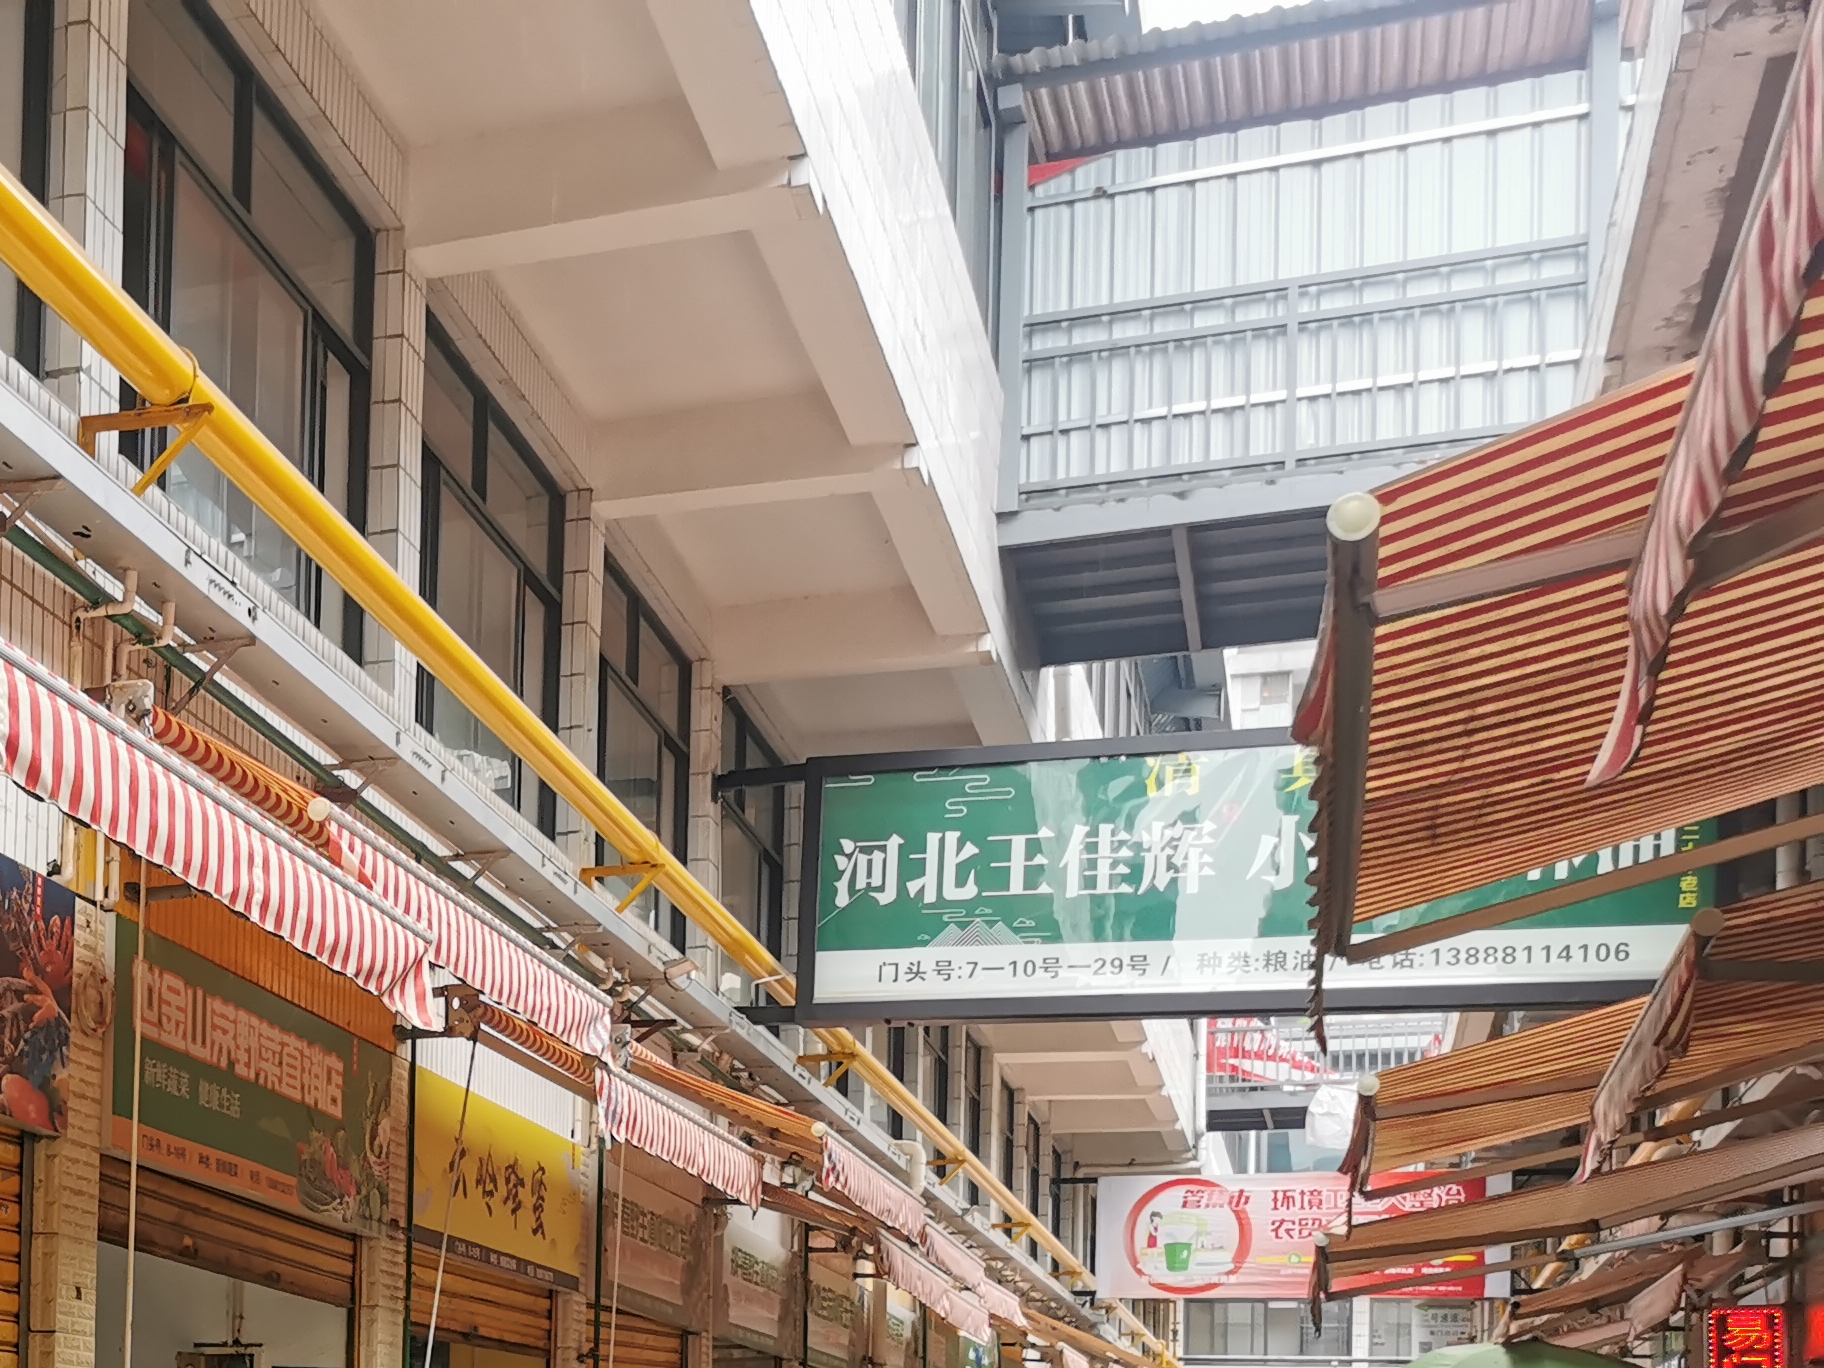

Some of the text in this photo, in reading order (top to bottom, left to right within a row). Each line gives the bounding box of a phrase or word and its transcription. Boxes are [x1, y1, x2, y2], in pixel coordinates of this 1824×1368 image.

[833, 819, 1217, 909] 河北王佳辉
